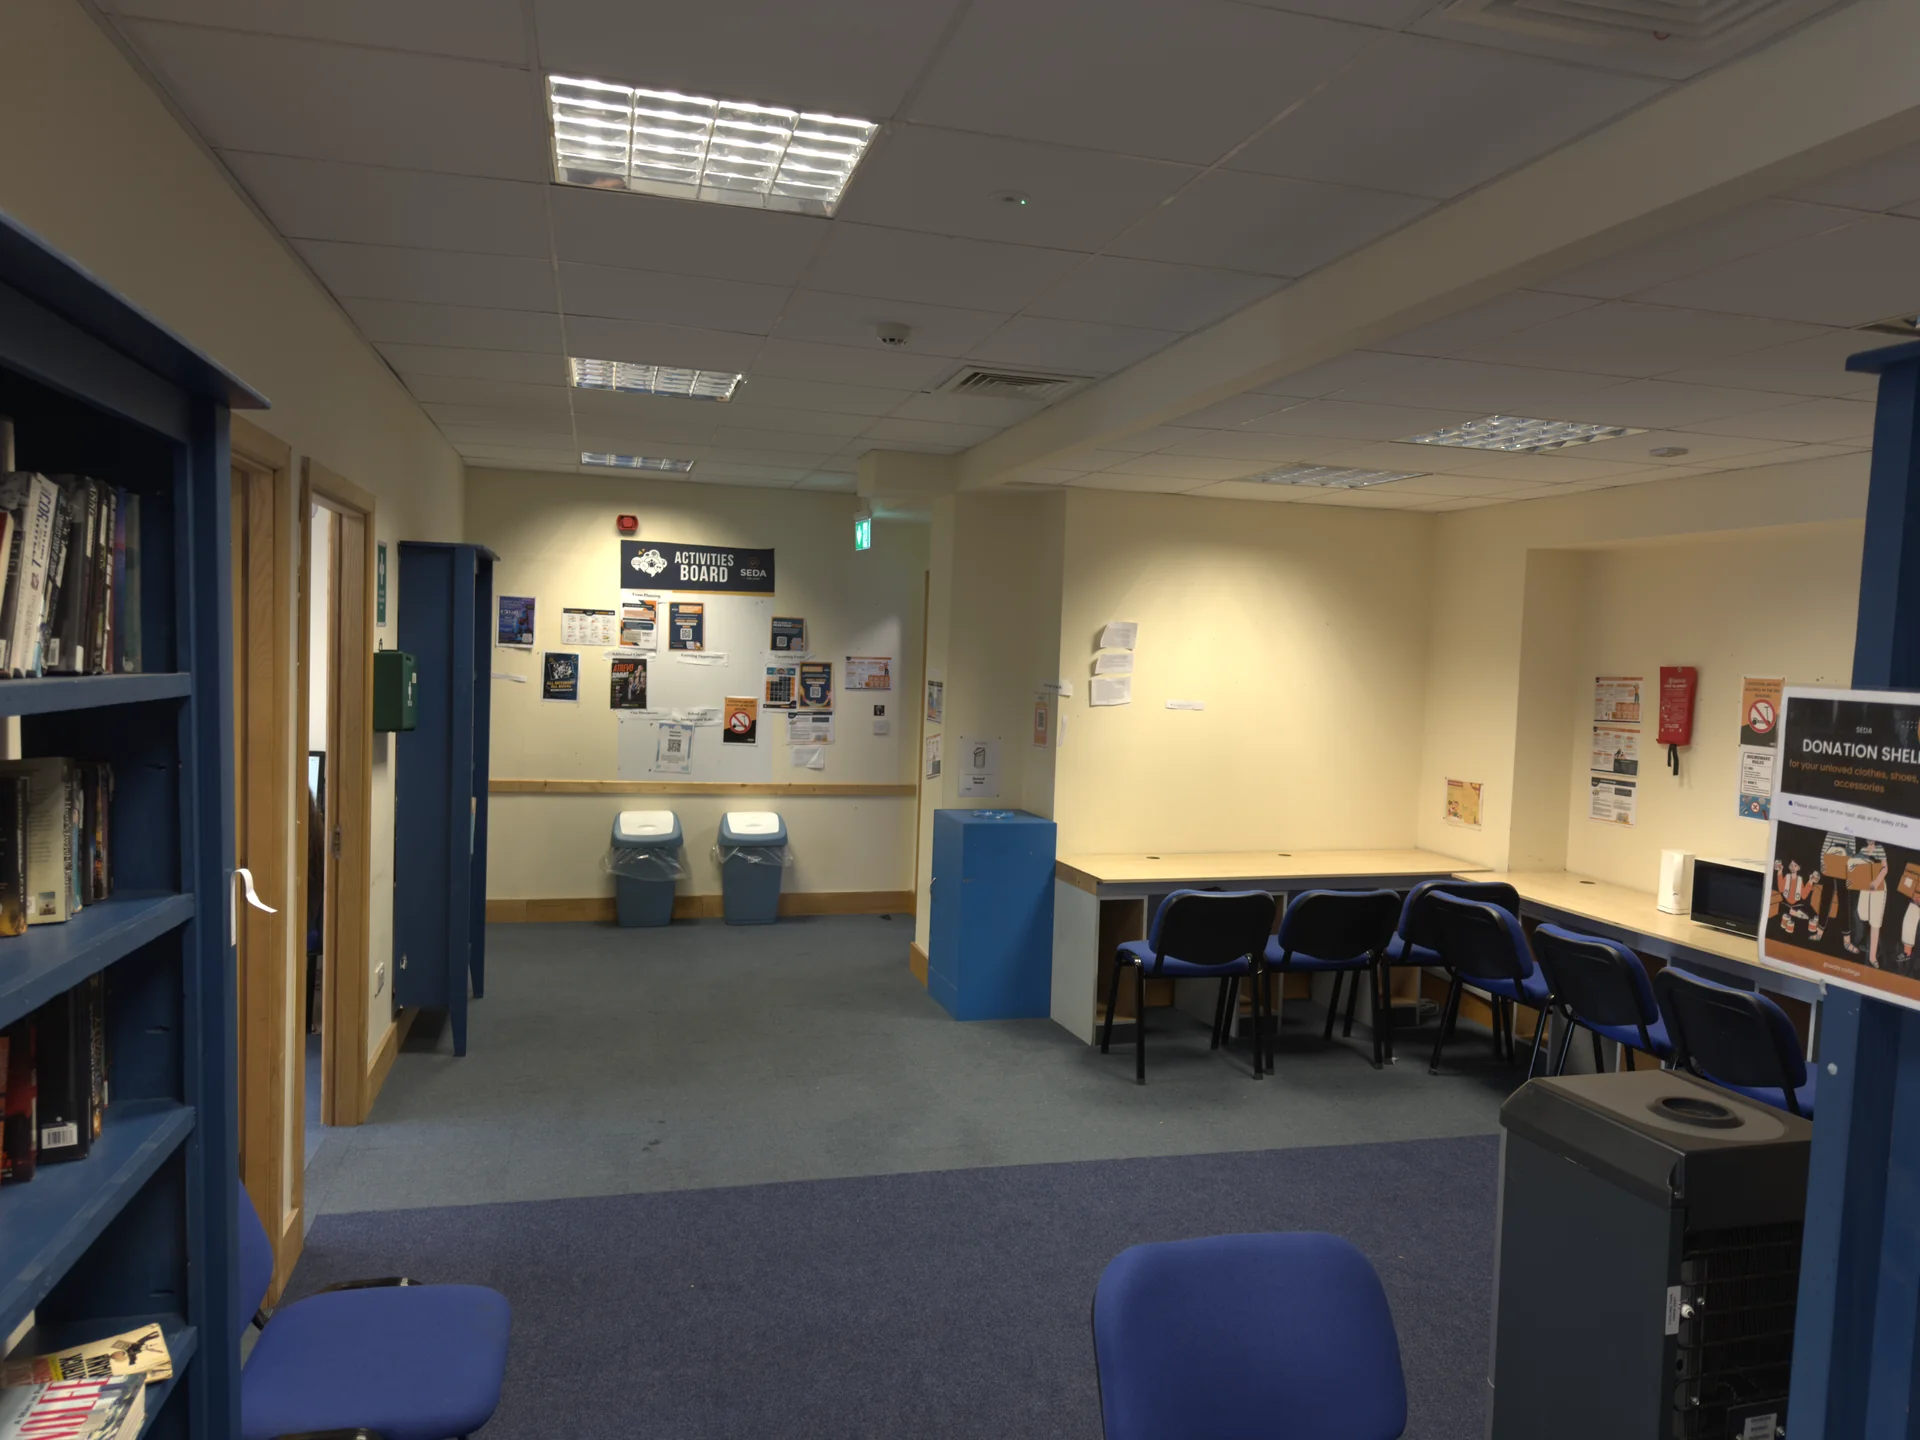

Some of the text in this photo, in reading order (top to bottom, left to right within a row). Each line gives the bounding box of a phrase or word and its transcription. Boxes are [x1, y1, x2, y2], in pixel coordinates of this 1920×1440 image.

[675, 551, 734, 567] ACTIVITIES
[680, 565, 728, 583] BOARD
[740, 568, 767, 577] SEDA
[1856, 726, 1872, 734] SEDA
[1802, 739, 1878, 760] DONATION
[1789, 759, 1919, 784] for your unloved clothes, shoes,
[1834, 780, 1885, 793] accessories
